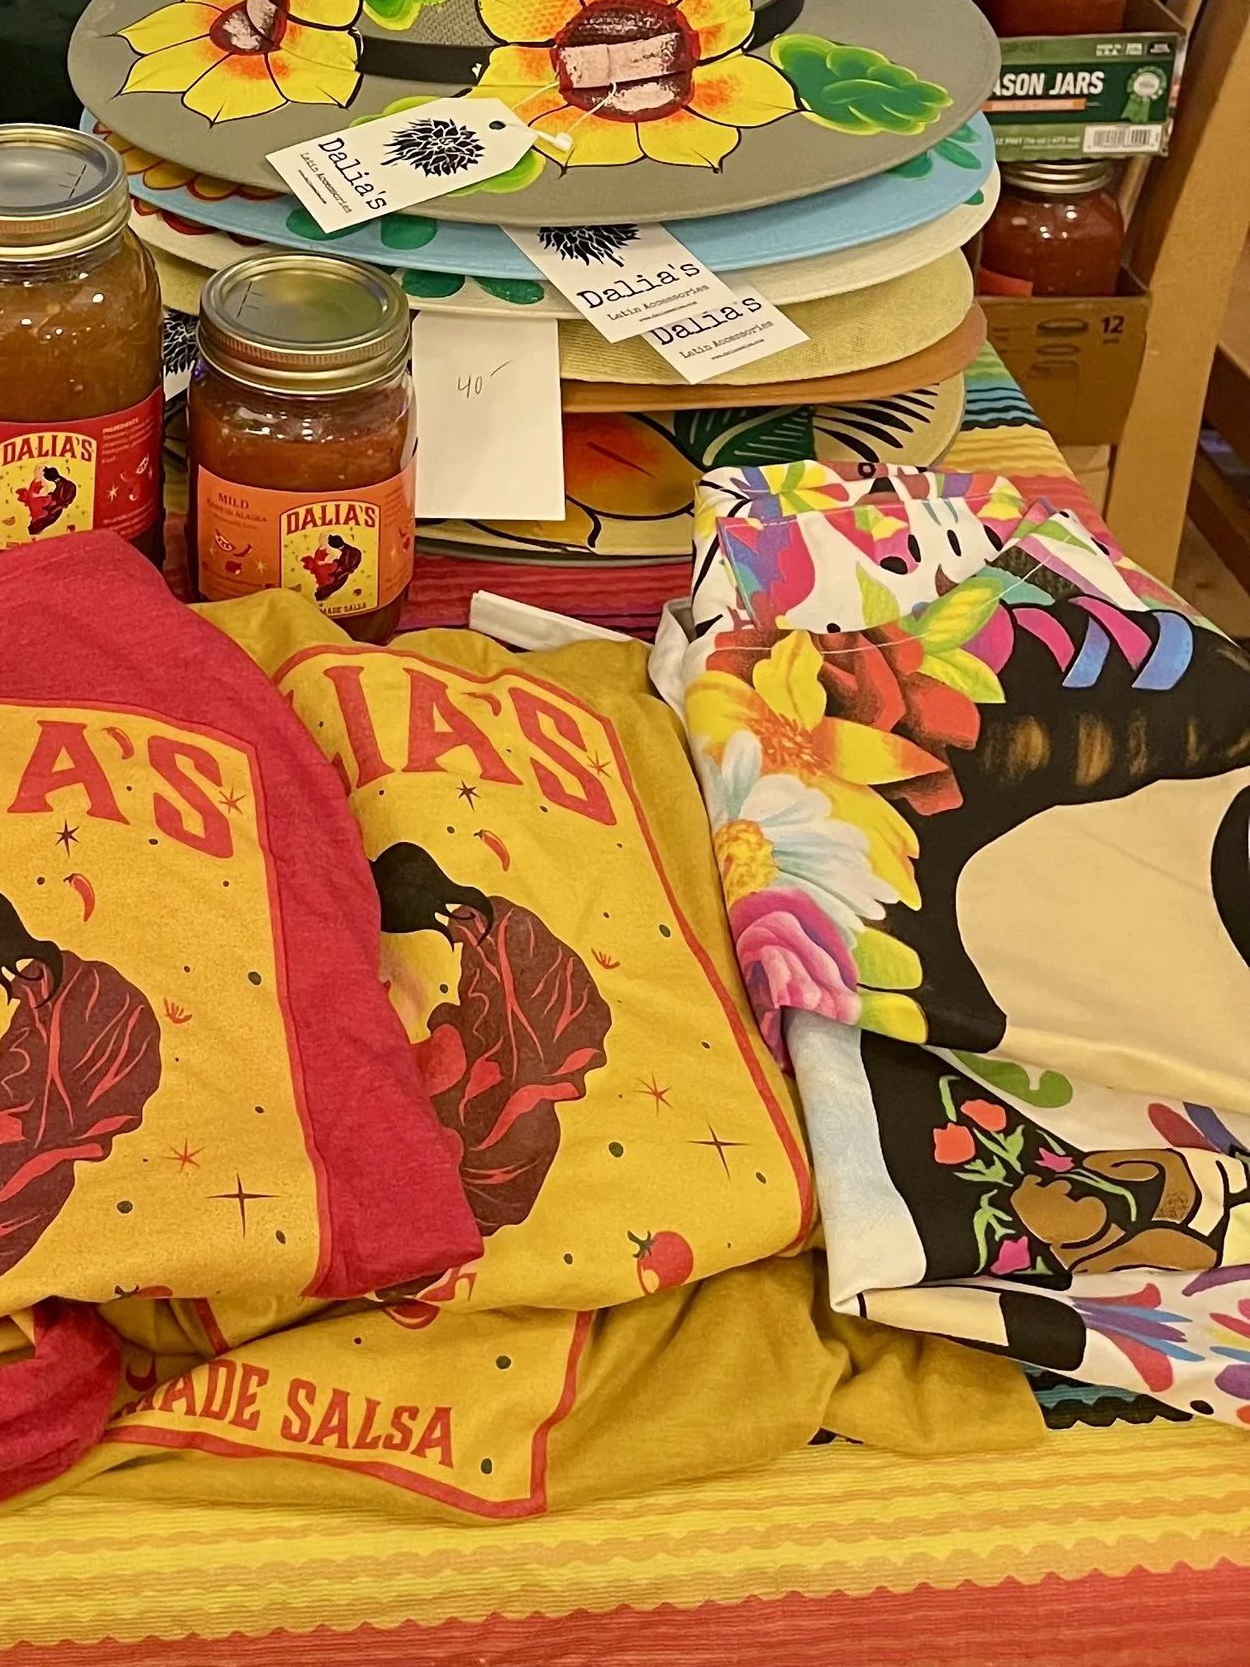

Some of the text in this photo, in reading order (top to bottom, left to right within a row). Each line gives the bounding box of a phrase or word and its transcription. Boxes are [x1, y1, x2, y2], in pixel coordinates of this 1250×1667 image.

[1048, 71, 1105, 94] JARS
[318, 137, 387, 210] Dalia's
[577, 262, 700, 309] Dalia's
[607, 305, 642, 321] Latin
[643, 284, 709, 308] Accessories
[1101, 315, 1125, 334] 12
[679, 343, 712, 359] Latin
[2, 435, 94, 466] DALIA'S
[218, 492, 249, 509] MILD
[286, 503, 376, 535] DALIA'S
[285, 665, 617, 826] IA'S
[280, 1377, 455, 1469] SALSA
